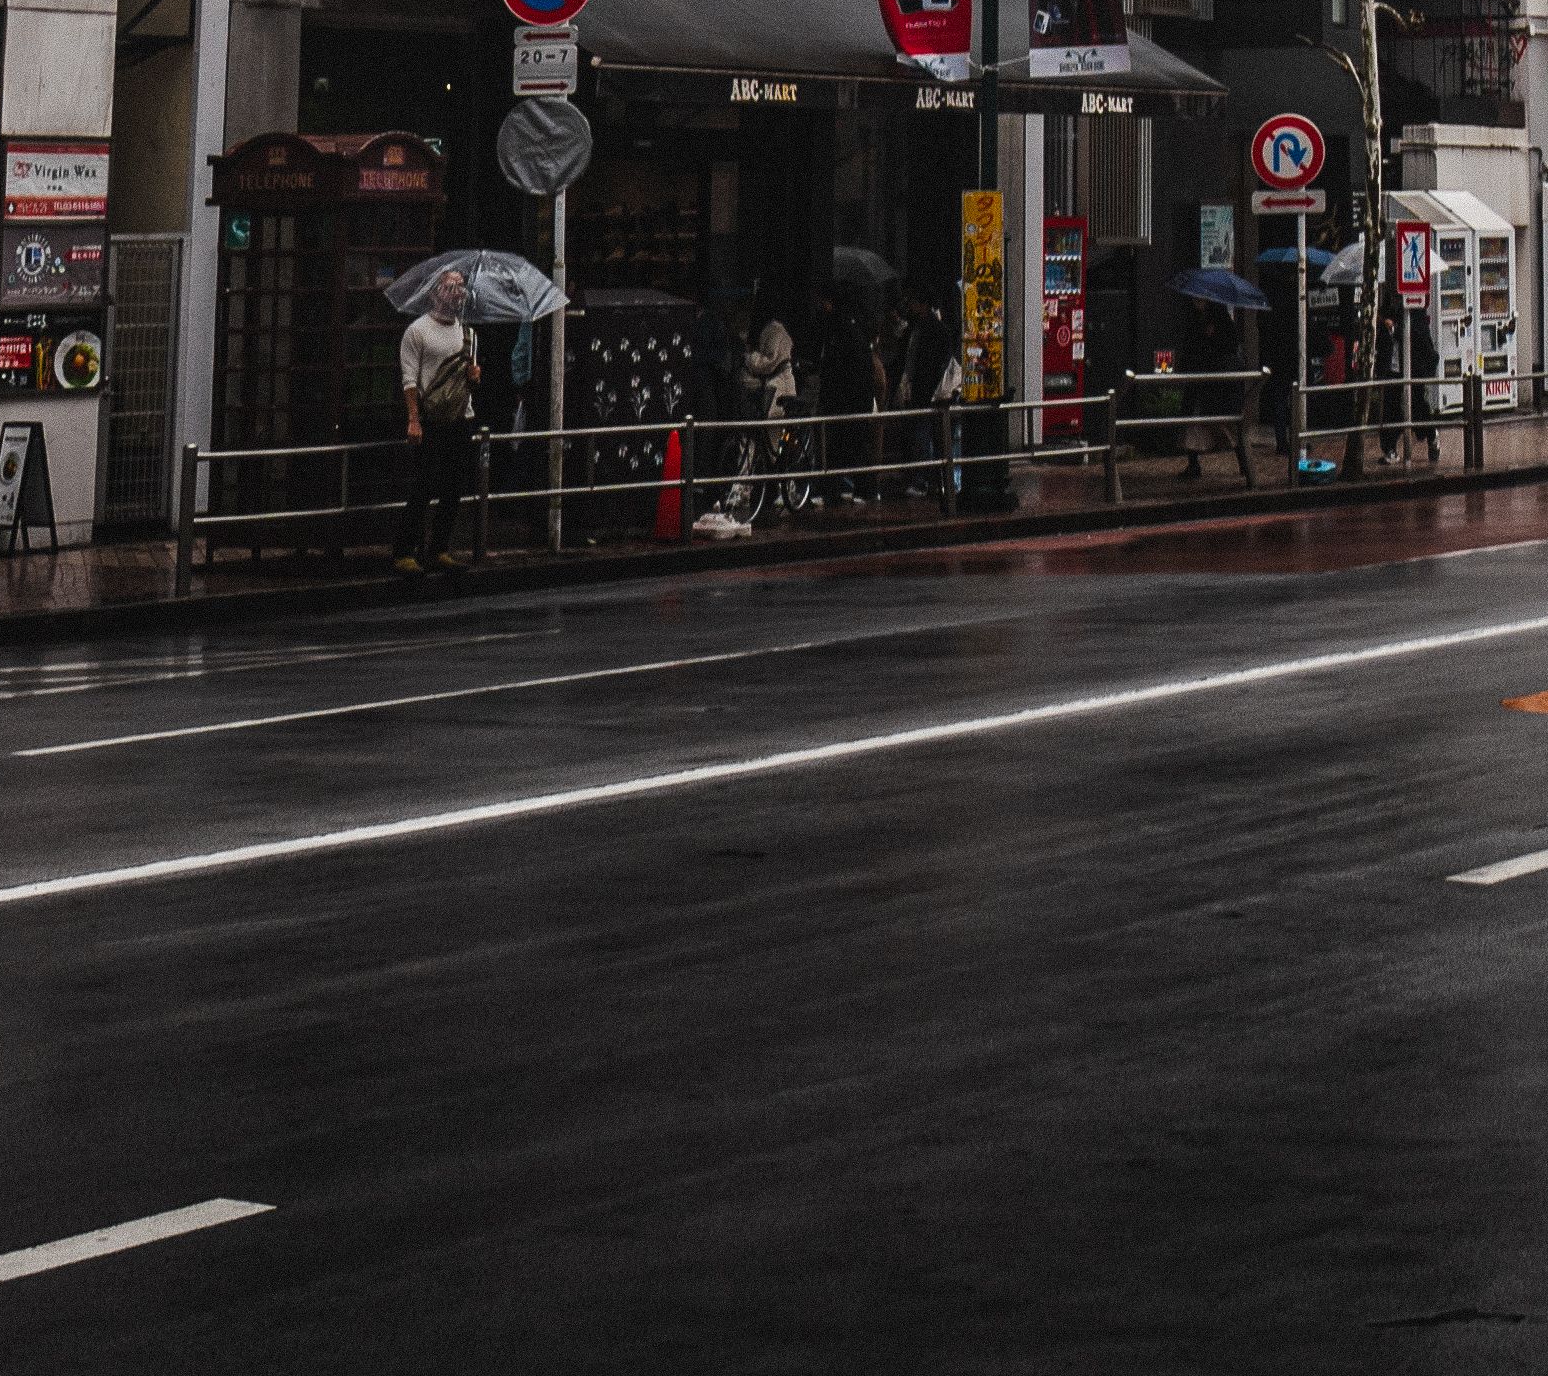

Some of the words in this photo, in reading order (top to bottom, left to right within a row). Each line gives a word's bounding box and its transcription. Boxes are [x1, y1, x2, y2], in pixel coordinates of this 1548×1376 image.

[520, 48, 570, 66] 20-7
[730, 78, 798, 104] ABC-MART
[915, 86, 975, 111] ABC-MART
[1080, 91, 1135, 115] ABC-MART
[34, 163, 70, 180] Virgin
[73, 164, 98, 178] Wax
[238, 171, 315, 191] TELEPHONE
[359, 169, 429, 190] TELEPHONE
[1485, 380, 1511, 397] KIRIN
